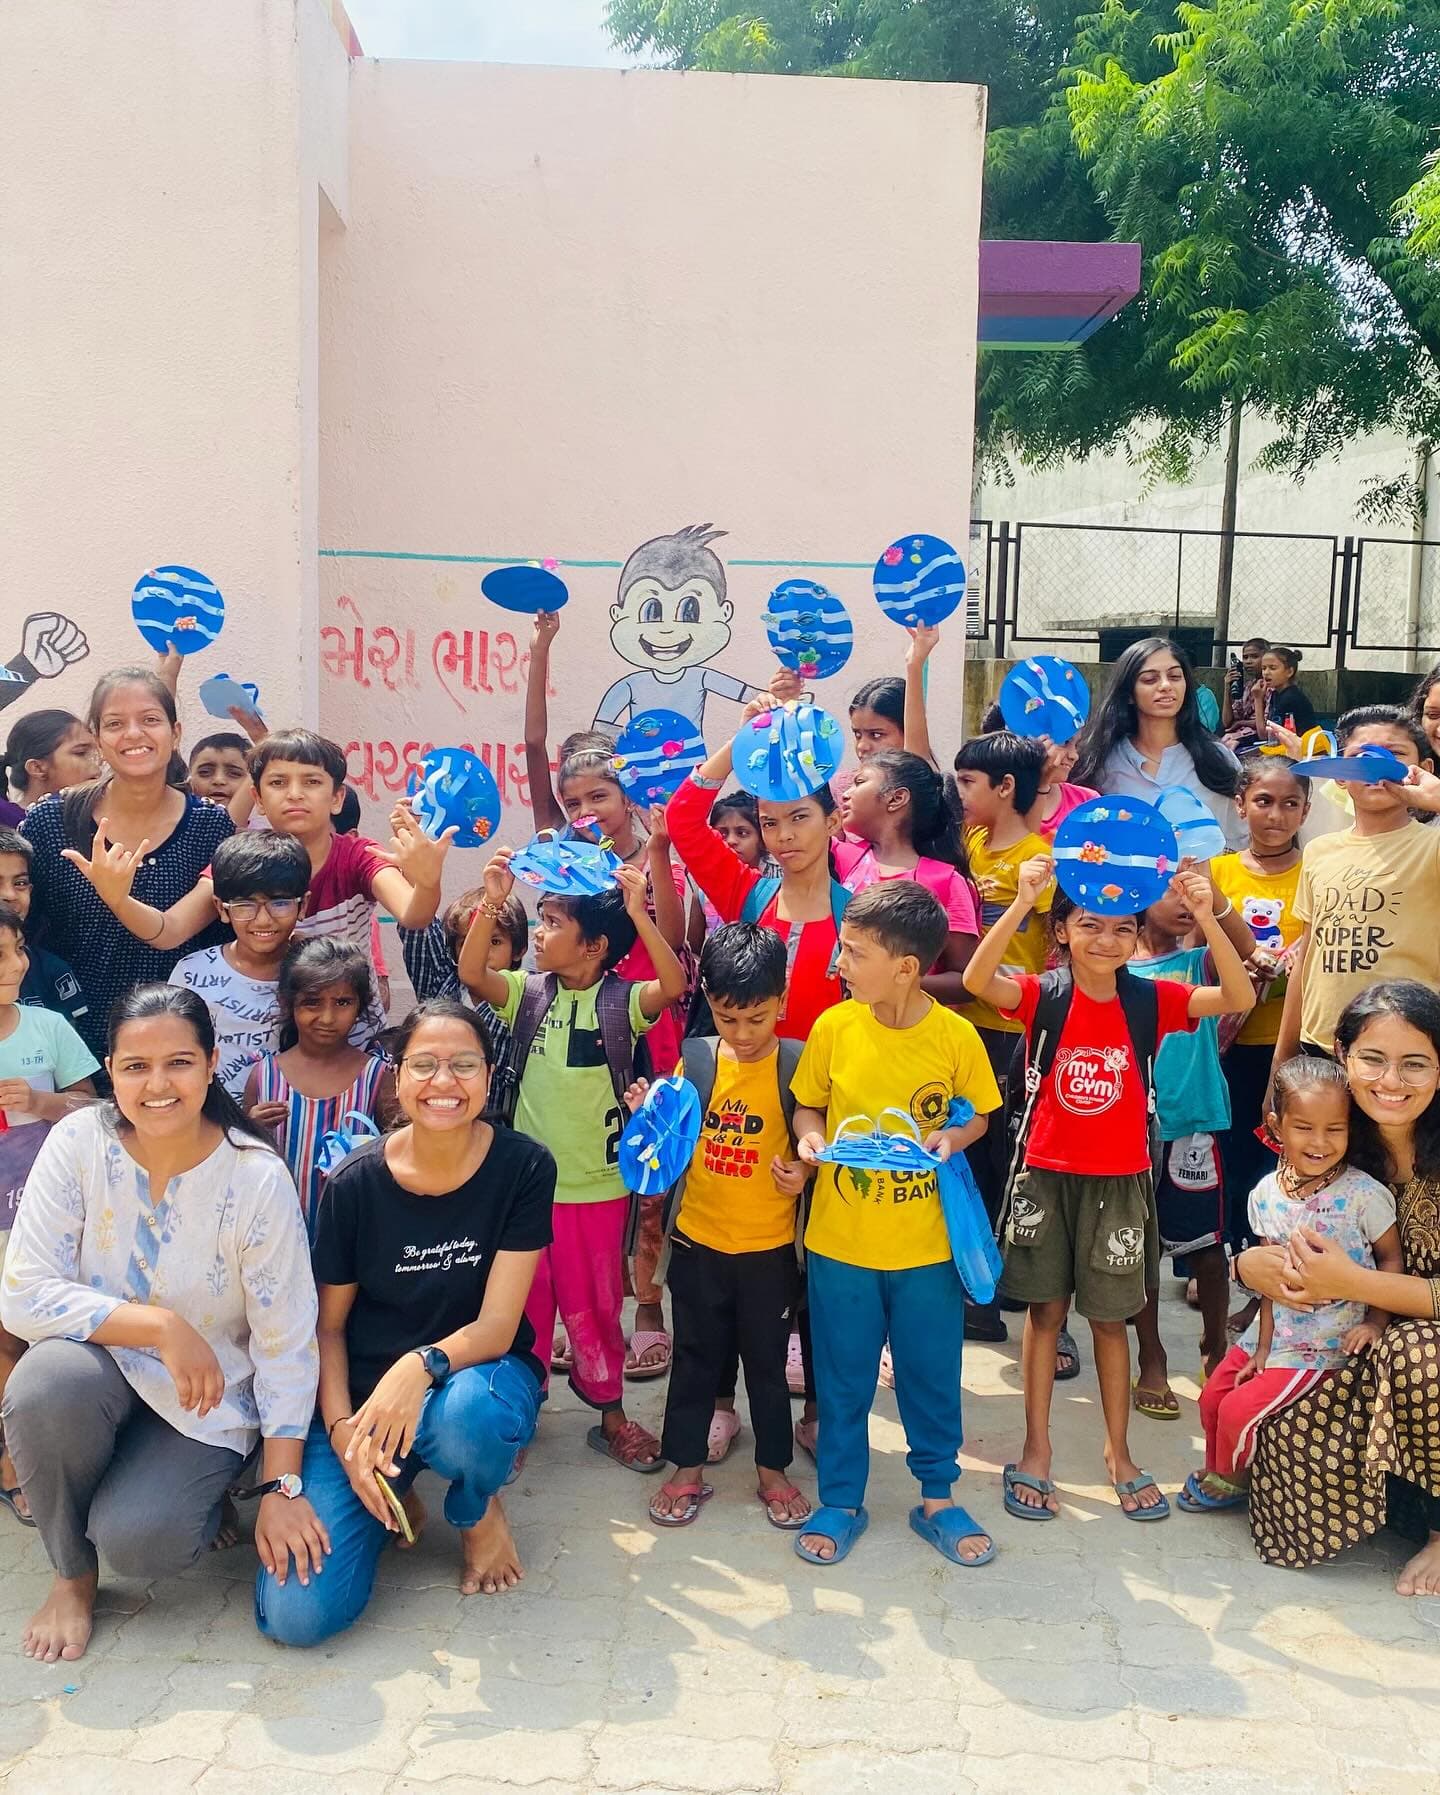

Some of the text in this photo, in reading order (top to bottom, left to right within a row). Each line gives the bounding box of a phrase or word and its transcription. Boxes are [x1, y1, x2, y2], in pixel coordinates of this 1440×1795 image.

[320, 594, 421, 689] મેરા
[1324, 887, 1385, 912] DAD
[1320, 912, 1367, 927] is a
[1315, 926, 1394, 948] SUPER
[1322, 948, 1379, 973] HERO
[1067, 1060, 1099, 1078] MY
[1069, 1077, 1113, 1098] GYM
[721, 1098, 749, 1115] My
[705, 1111, 764, 1135] DAD
[713, 1131, 745, 1146] is a
[705, 1139, 759, 1164] SUPER
[704, 1155, 753, 1178] HERO
[1178, 1167, 1208, 1181] FERRARI
[893, 1178, 936, 1204] BAN
[403, 1245, 420, 1259] Be
[419, 1239, 454, 1261] grateful
